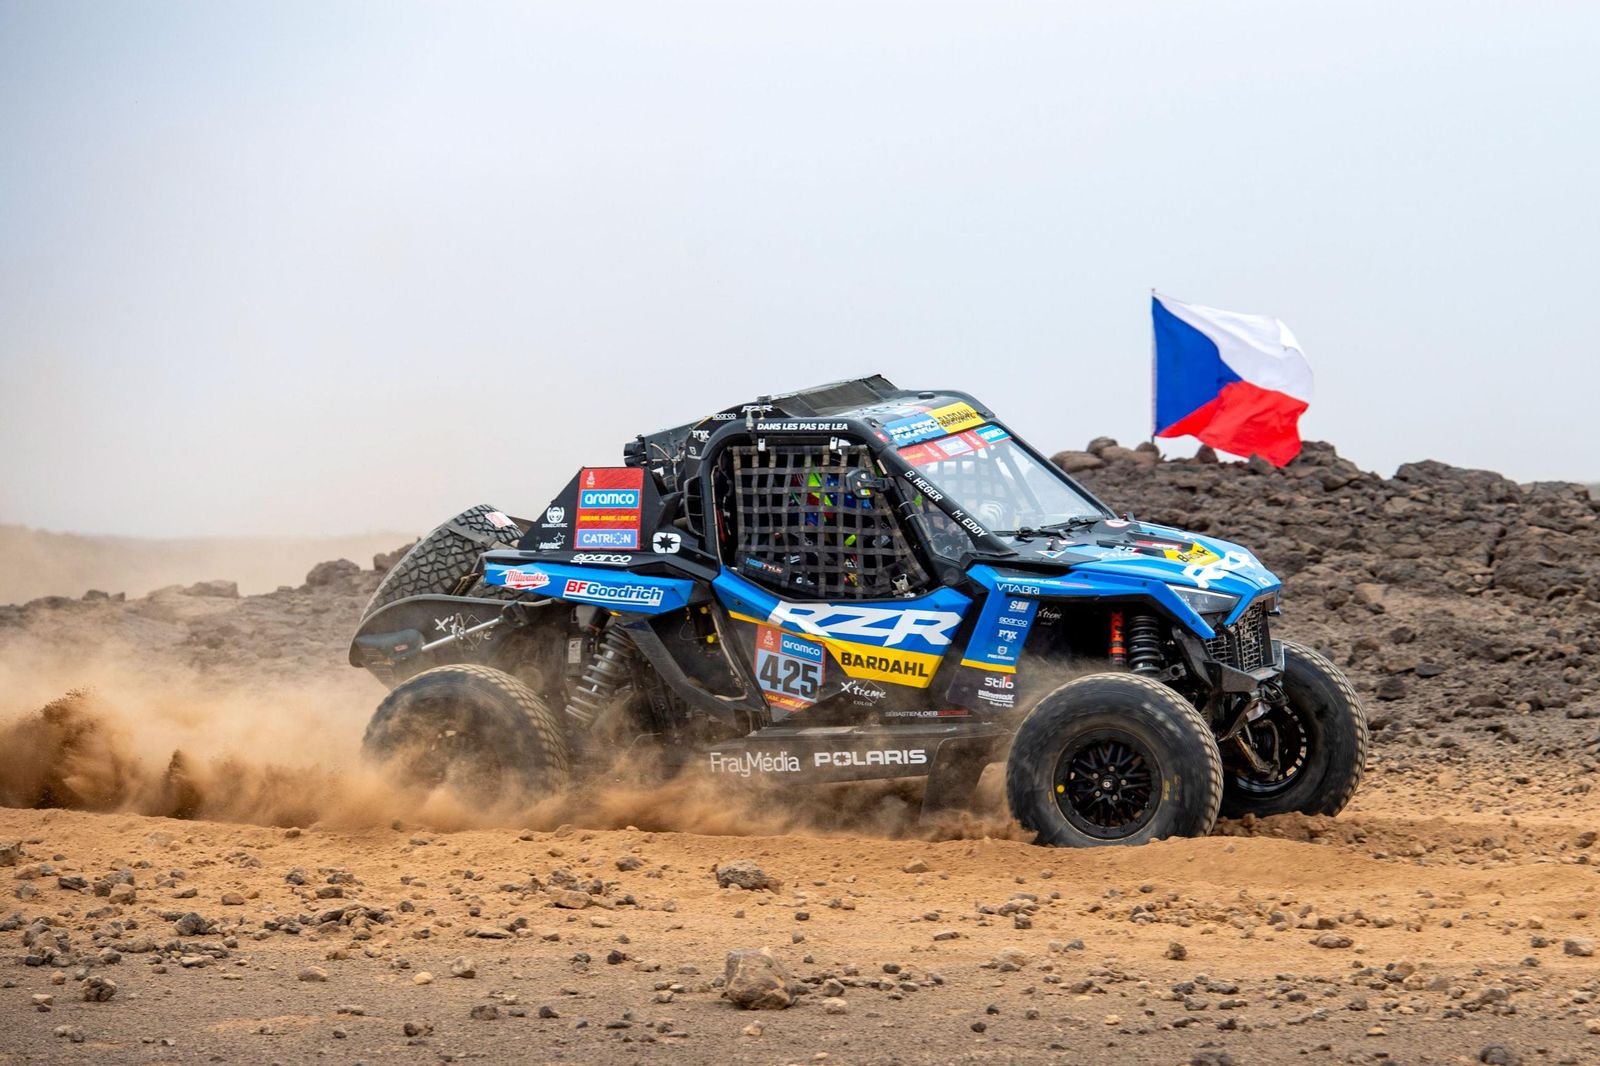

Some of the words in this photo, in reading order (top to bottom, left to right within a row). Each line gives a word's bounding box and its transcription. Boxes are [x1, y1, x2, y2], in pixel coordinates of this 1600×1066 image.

[757, 423, 782, 431] DANS
[782, 423, 798, 431] LES
[799, 423, 817, 431] PAS
[818, 423, 829, 431] DE
[831, 423, 848, 431] LEA
[904, 470, 915, 480] B.
[913, 477, 943, 502] HEGER
[585, 493, 635, 505] aramco
[952, 509, 964, 520] M.
[961, 518, 988, 537] EDDY
[570, 553, 633, 564] sparco
[506, 570, 548, 583] Milwaukee
[566, 580, 662, 600] BFGoodrich
[767, 600, 963, 647] RZR
[999, 617, 1028, 627] sparco
[998, 629, 1018, 642] FOX
[783, 640, 820, 656] aramco
[841, 652, 929, 678] BARDAHL
[760, 654, 819, 700] 425
[984, 676, 1014, 689] Stilo
[840, 680, 886, 699] X'treme
[710, 749, 801, 778] FrayMédia
[814, 749, 928, 767] POLARIS
